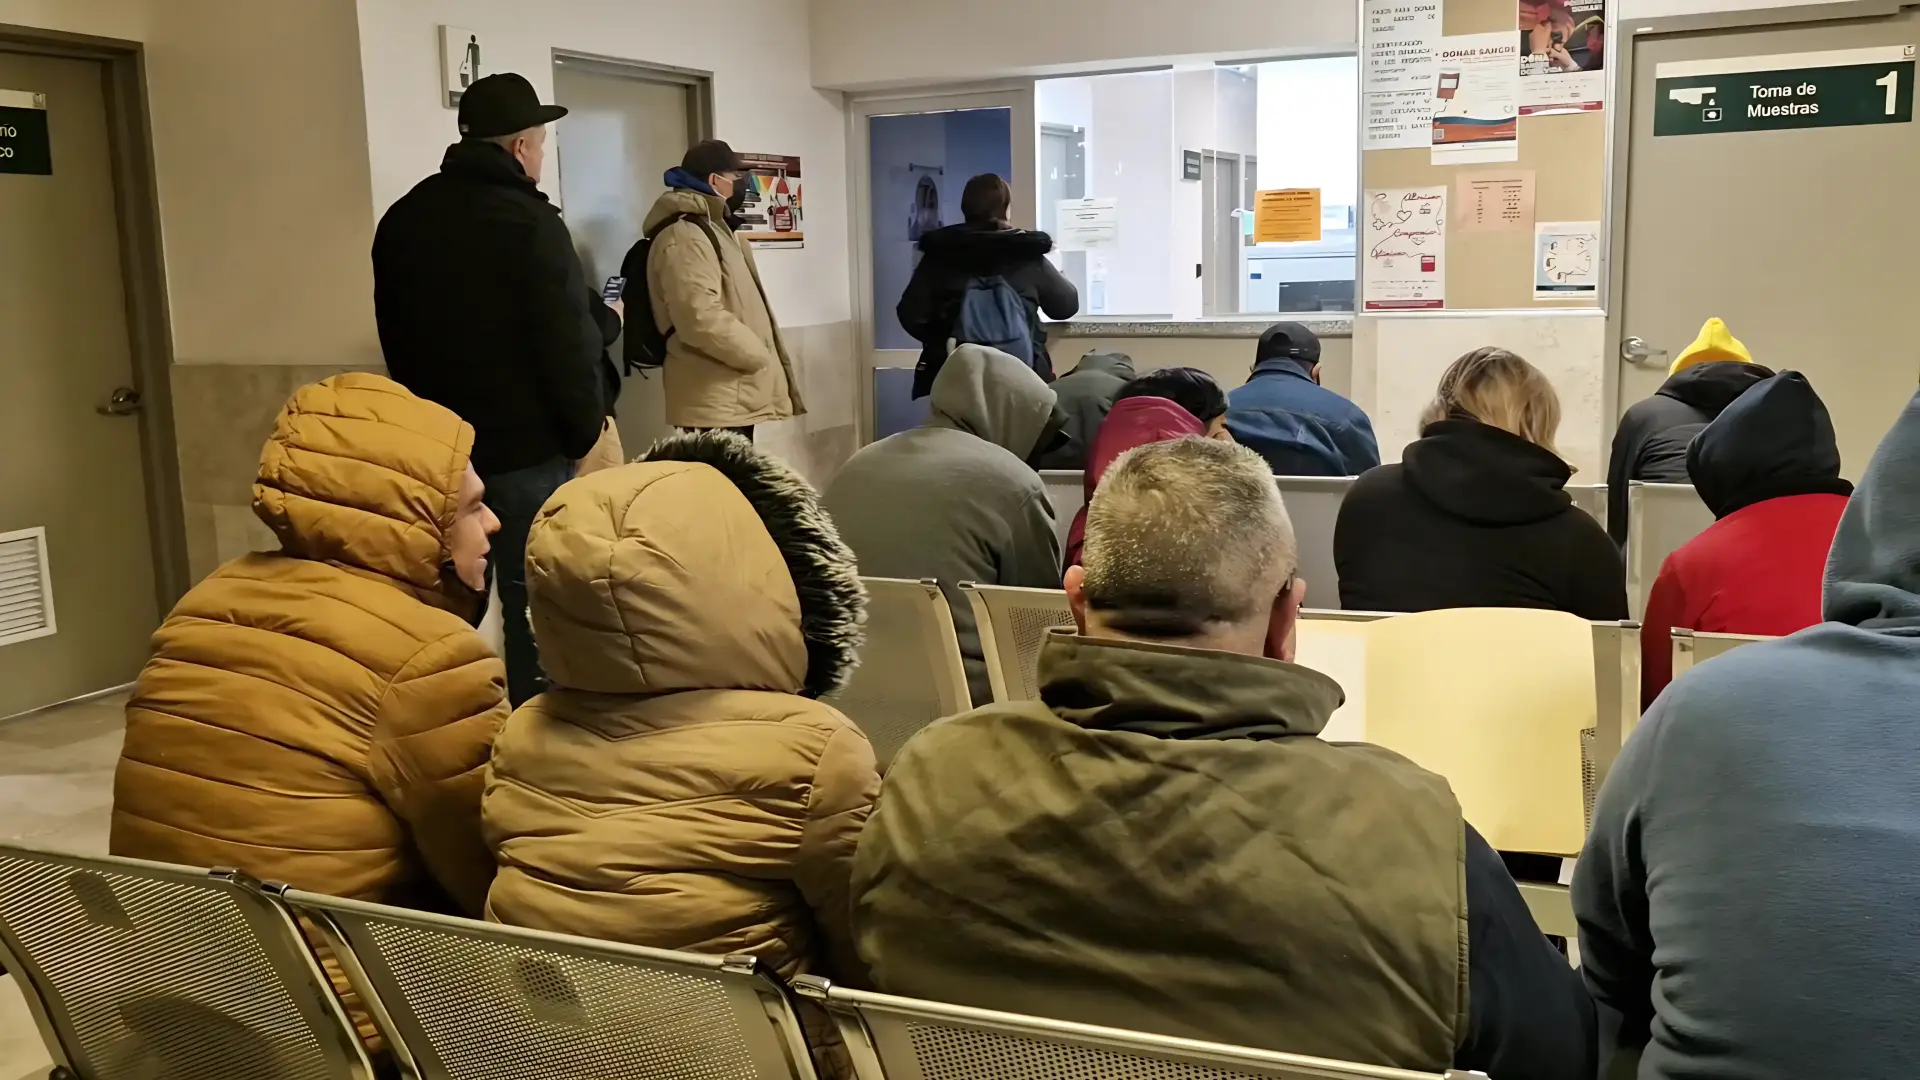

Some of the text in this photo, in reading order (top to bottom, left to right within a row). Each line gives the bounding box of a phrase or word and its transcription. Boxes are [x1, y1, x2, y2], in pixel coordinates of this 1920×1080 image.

[1749, 82, 1817, 99] Toma de
[1875, 70, 1898, 115] 1
[1747, 103, 1819, 118] Muestras
